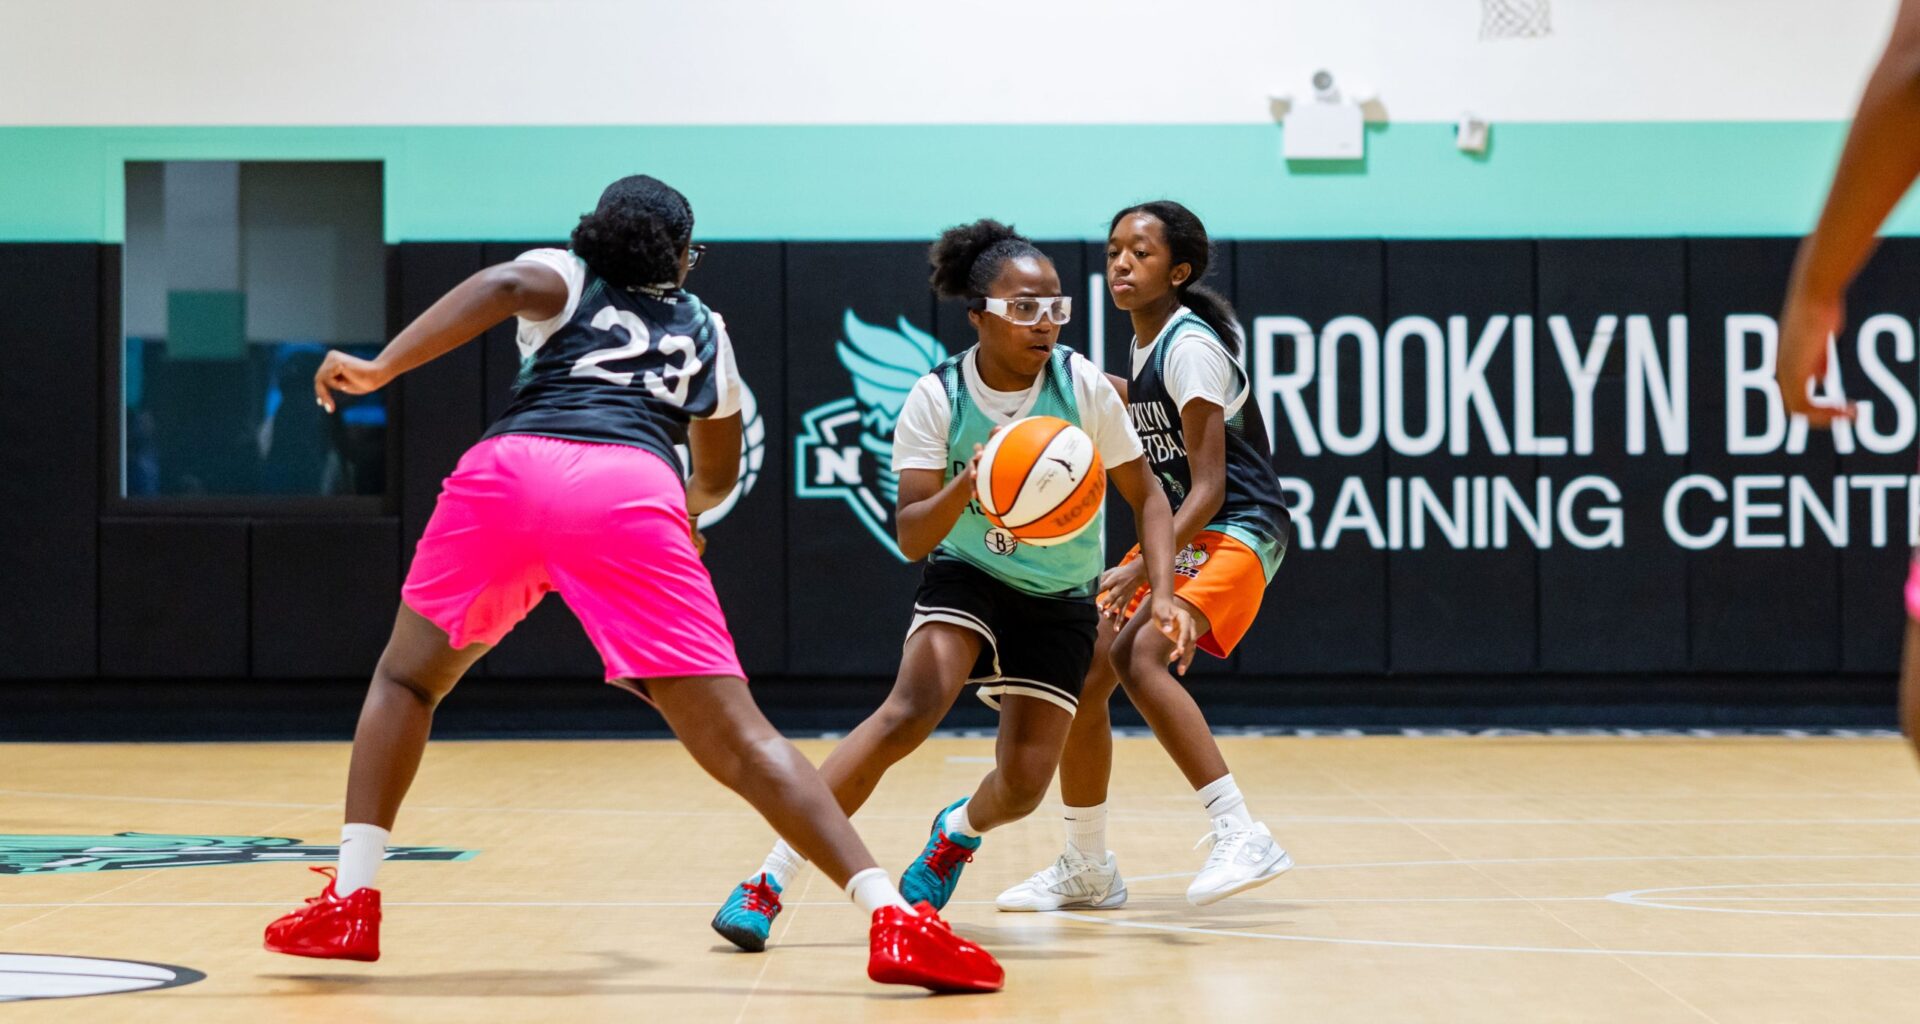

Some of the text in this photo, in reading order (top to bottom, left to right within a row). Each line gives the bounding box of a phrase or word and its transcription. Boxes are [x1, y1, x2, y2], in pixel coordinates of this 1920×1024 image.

[569, 305, 702, 408] 23
[1237, 314, 1920, 455] ROOKLYN BAS
[815, 446, 862, 484] N
[1279, 474, 1920, 549] RAINING CENT
